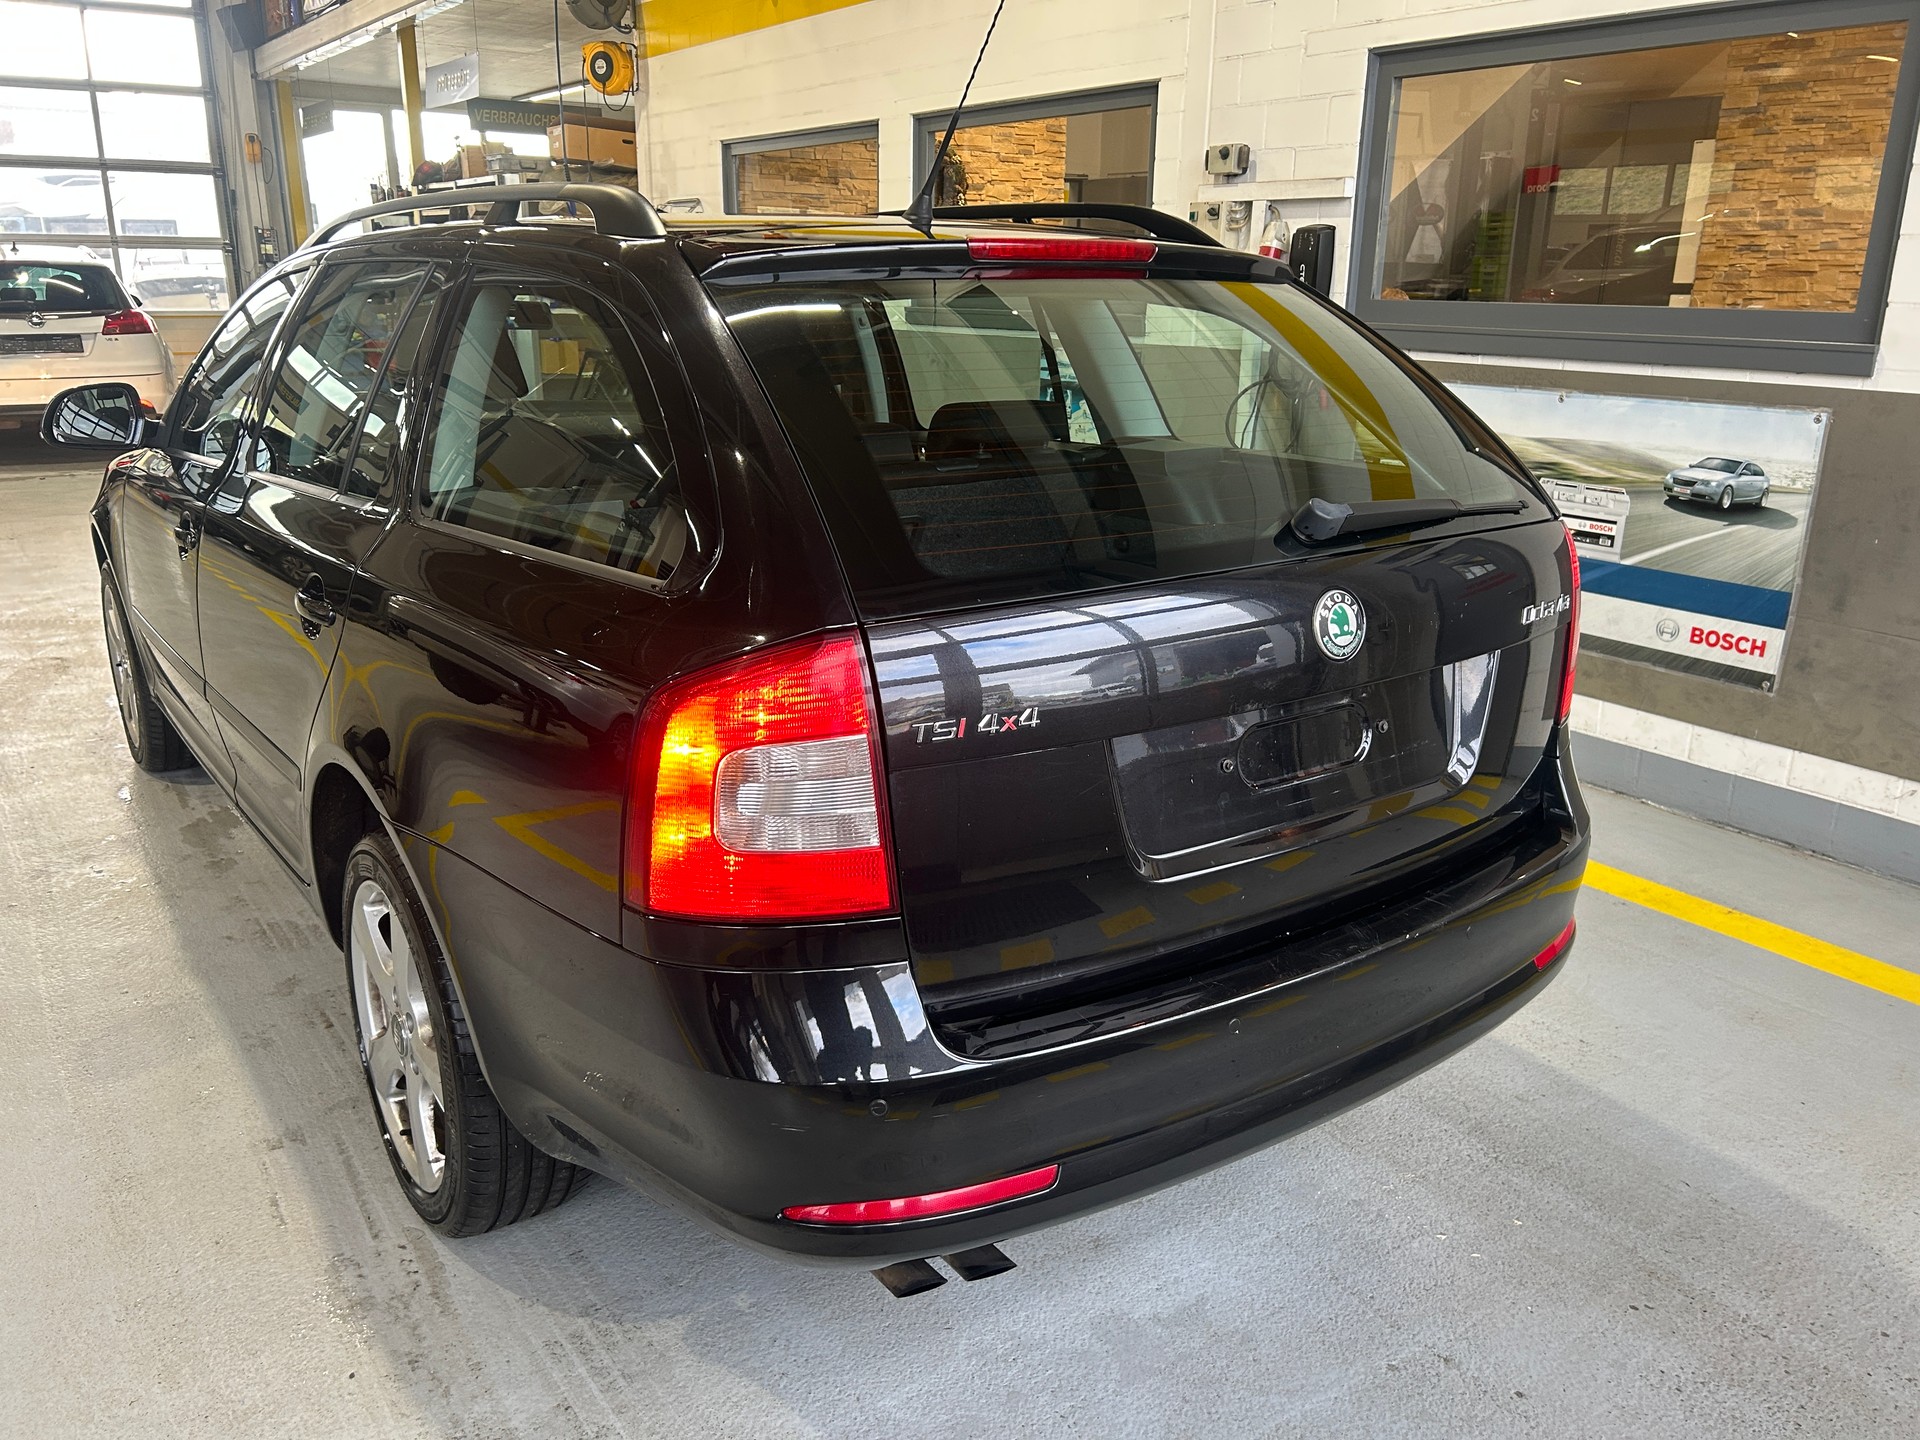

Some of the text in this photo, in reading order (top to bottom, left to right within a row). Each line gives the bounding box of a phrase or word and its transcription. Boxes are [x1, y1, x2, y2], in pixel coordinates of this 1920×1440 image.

[474, 108, 560, 127] VERBRAUCHS
[1589, 523, 1613, 533] BOSCH
[1521, 593, 1570, 625] Octavia
[1689, 626, 1767, 658] BOSCH
[912, 706, 1040, 743] TSI 4x4
